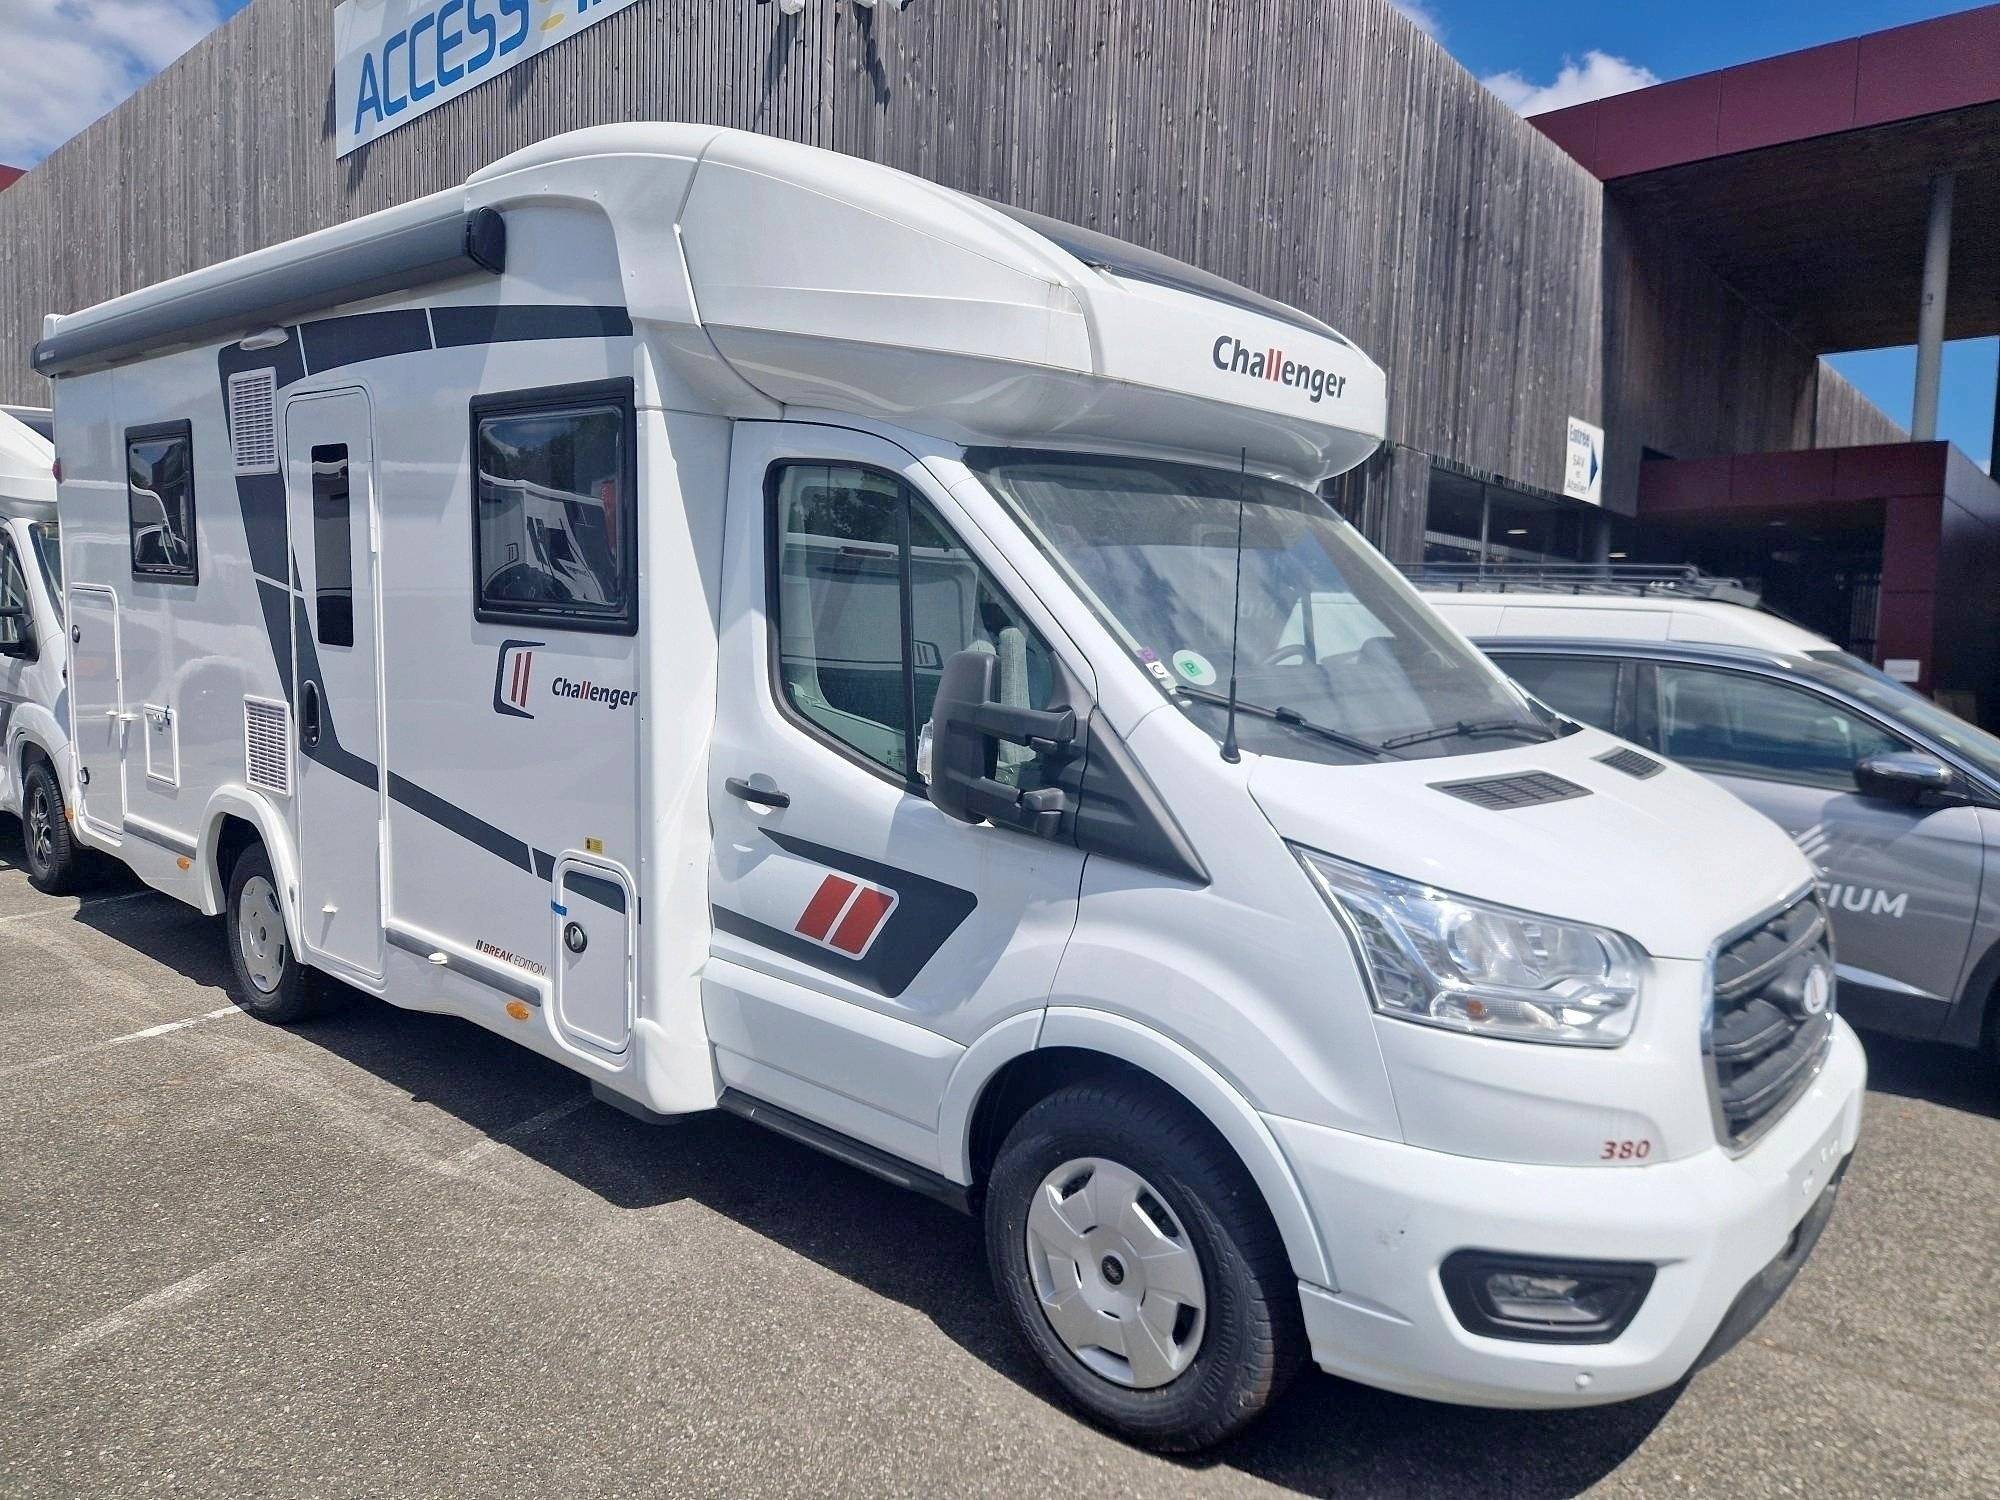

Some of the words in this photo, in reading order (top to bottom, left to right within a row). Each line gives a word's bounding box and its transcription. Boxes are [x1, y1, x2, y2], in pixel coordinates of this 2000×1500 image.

[354, 0, 529, 135] ACCESS
[1212, 335, 1346, 403] Challenger
[551, 677, 638, 710] Challenger
[483, 943, 513, 963] BREAK
[513, 954, 547, 976] EDITION
[1600, 1140, 1651, 1160] 380
